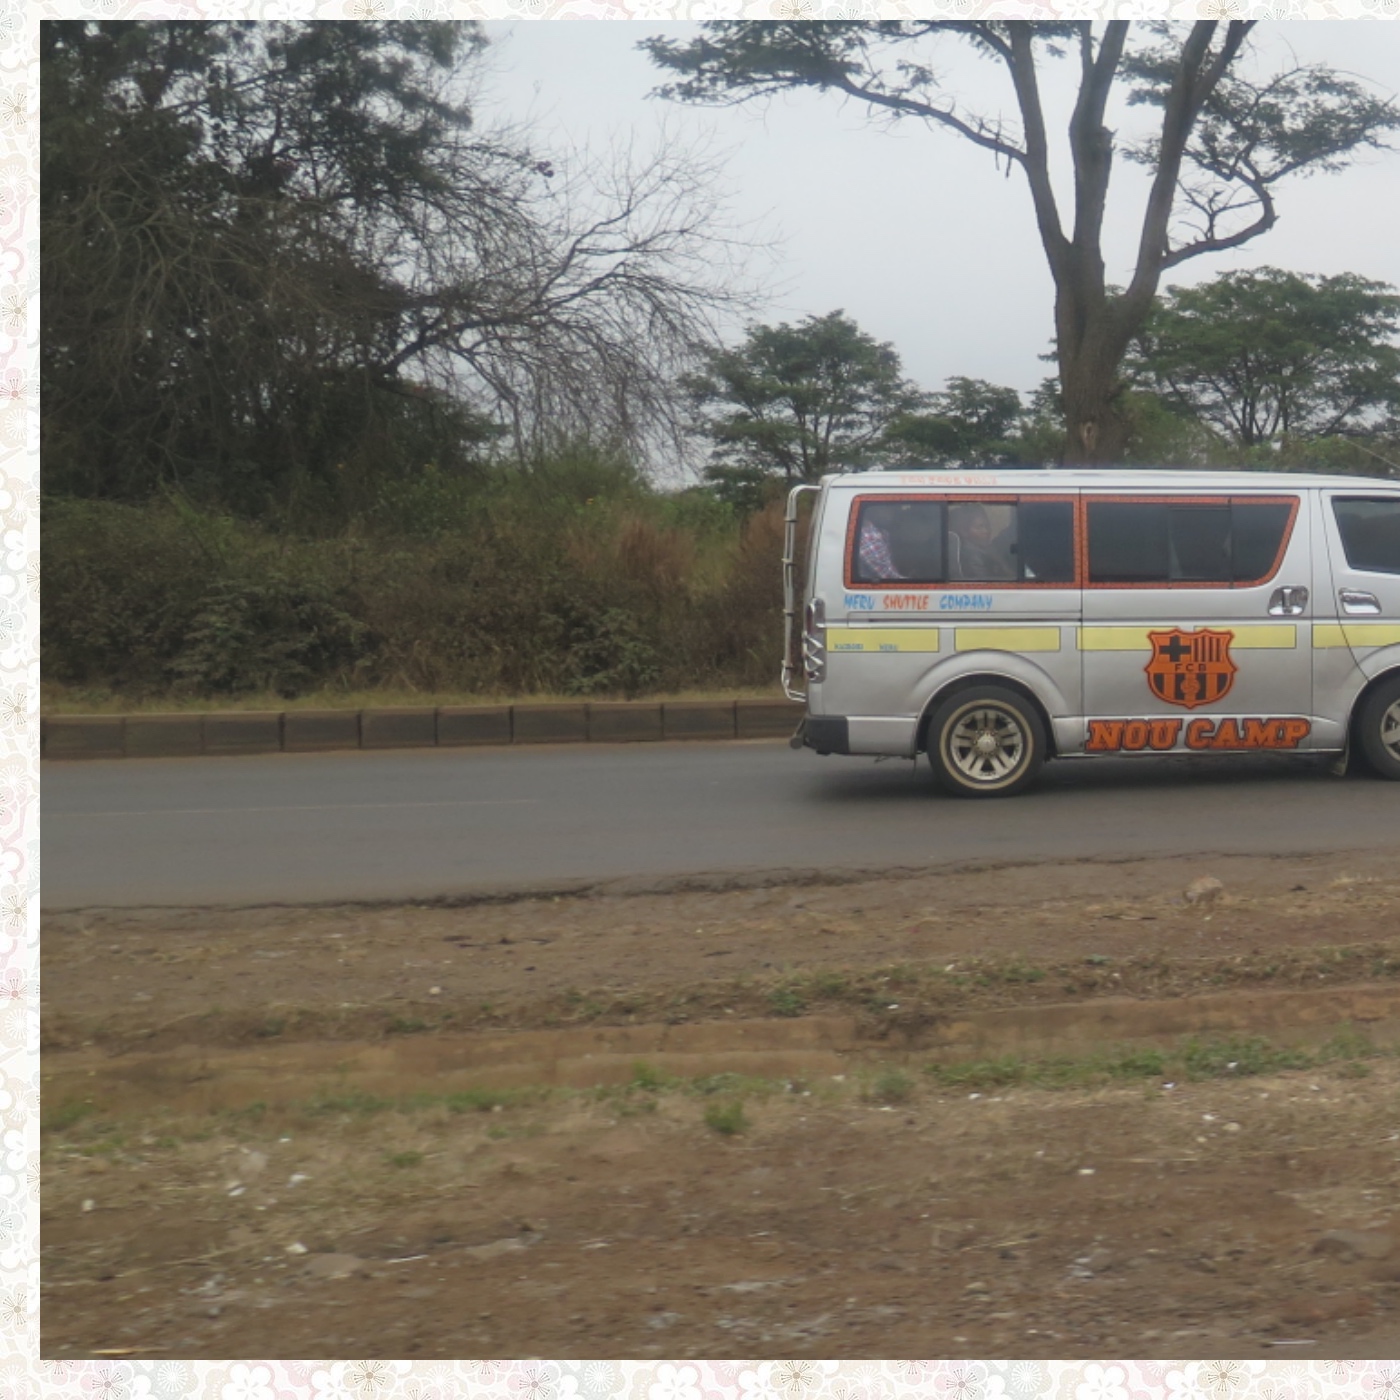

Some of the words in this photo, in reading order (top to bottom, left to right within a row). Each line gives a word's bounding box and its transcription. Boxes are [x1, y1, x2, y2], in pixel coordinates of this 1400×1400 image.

[843, 595, 875, 610] MERU
[882, 595, 930, 610] SHUTTLE
[939, 595, 993, 610] COMPANY
[1085, 718, 1182, 751] NOU
[1184, 717, 1311, 750] CAMP
